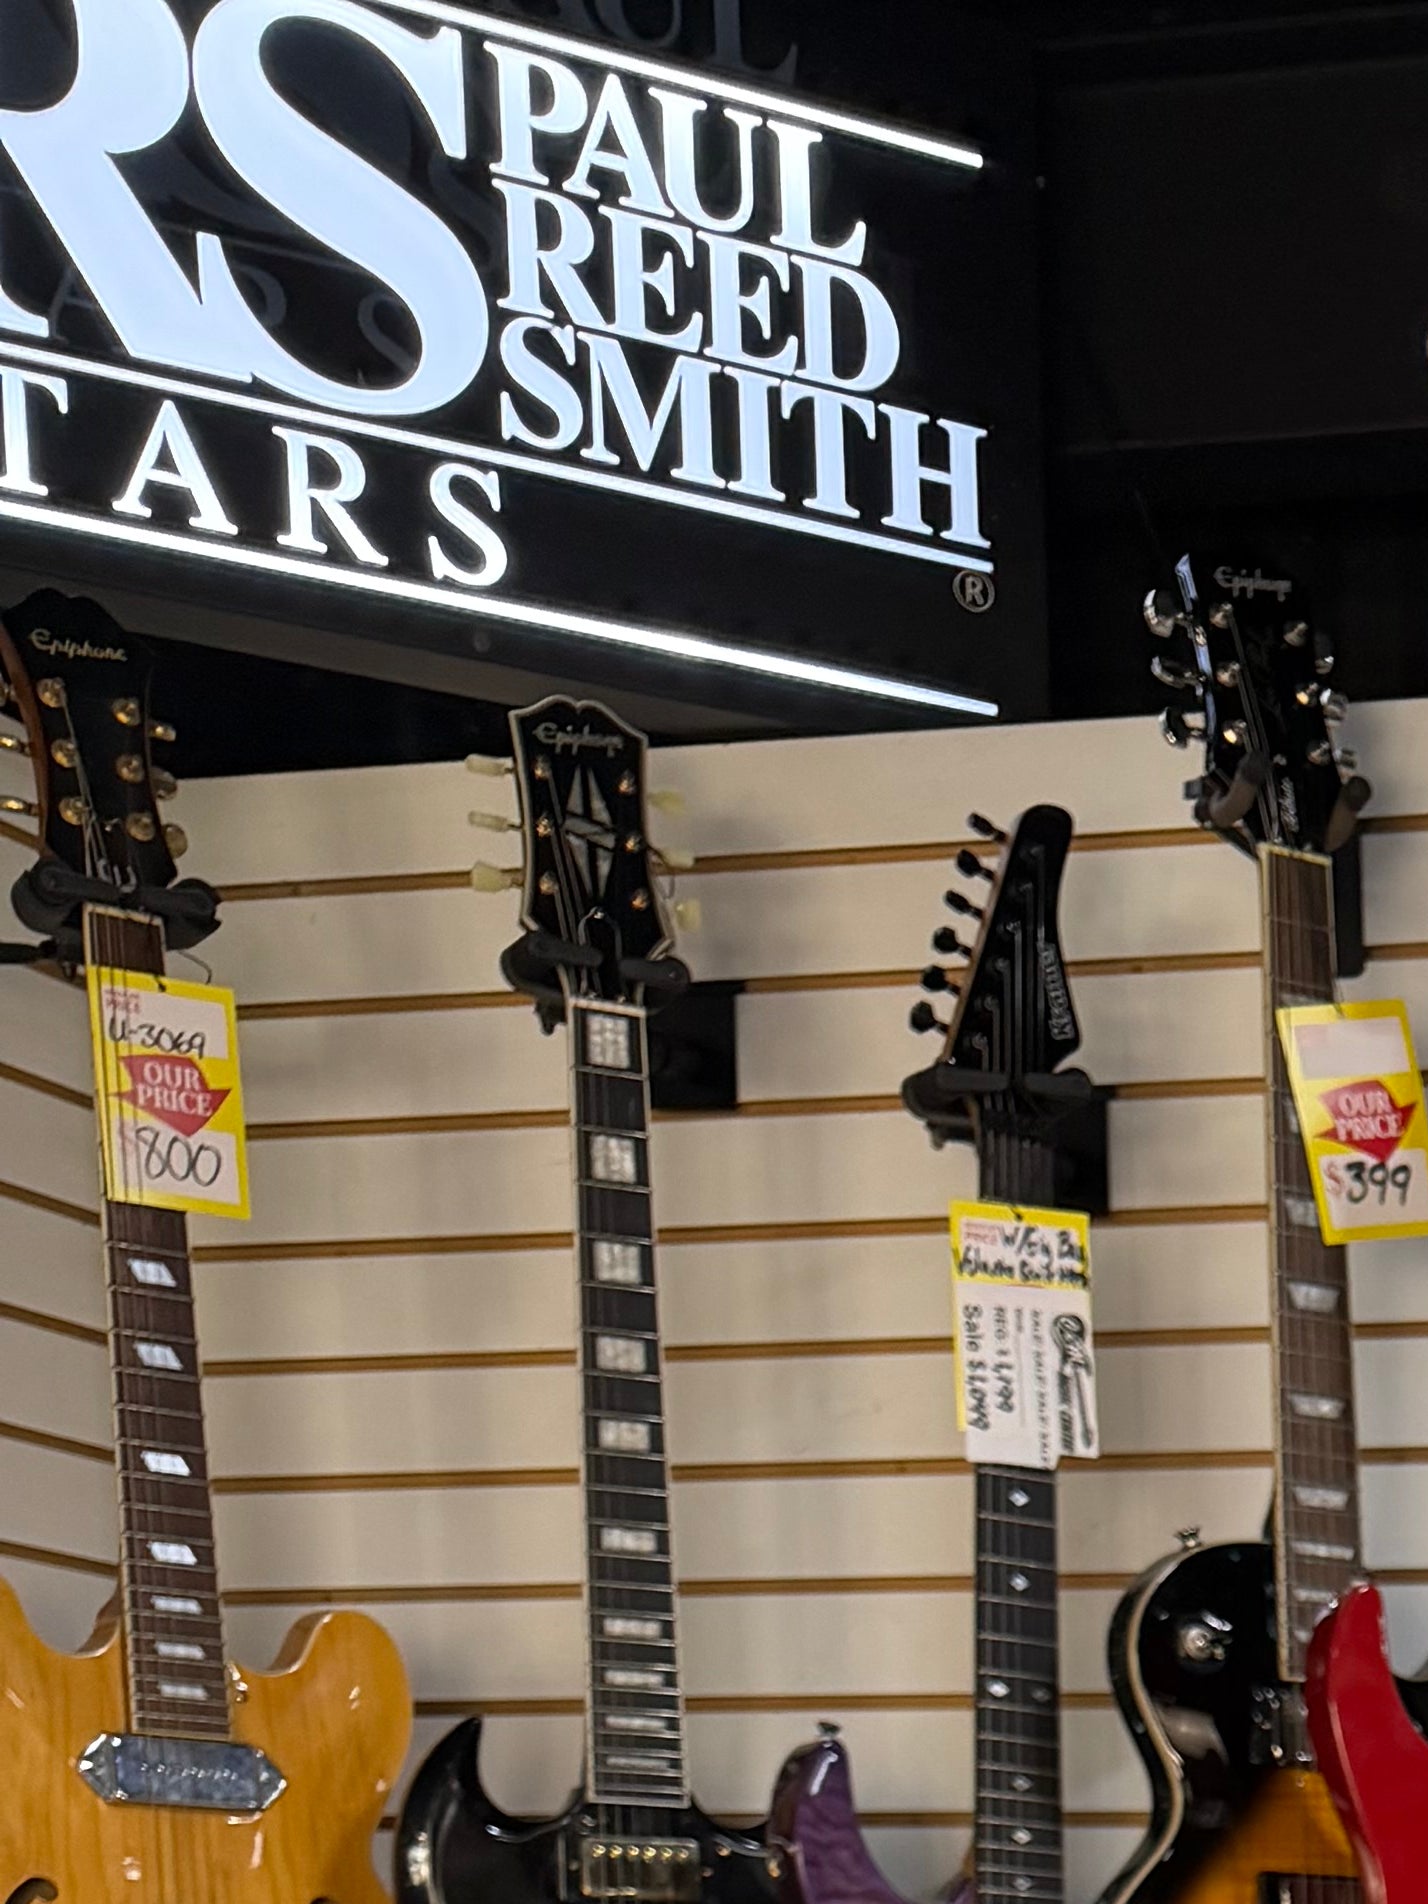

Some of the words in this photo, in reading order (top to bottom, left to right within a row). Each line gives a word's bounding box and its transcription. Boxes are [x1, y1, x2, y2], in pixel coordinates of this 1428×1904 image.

[483, 40, 868, 268] PAUL
[491, 177, 901, 393] REED
[499, 316, 993, 549] SMITH
[143, 1061, 201, 1092] OUR
[136, 1084, 213, 1117] PRICE
[1338, 1090, 1393, 1117] OUR
[1334, 1112, 1402, 1141] PRICE
[1325, 1160, 1412, 1206] $399
